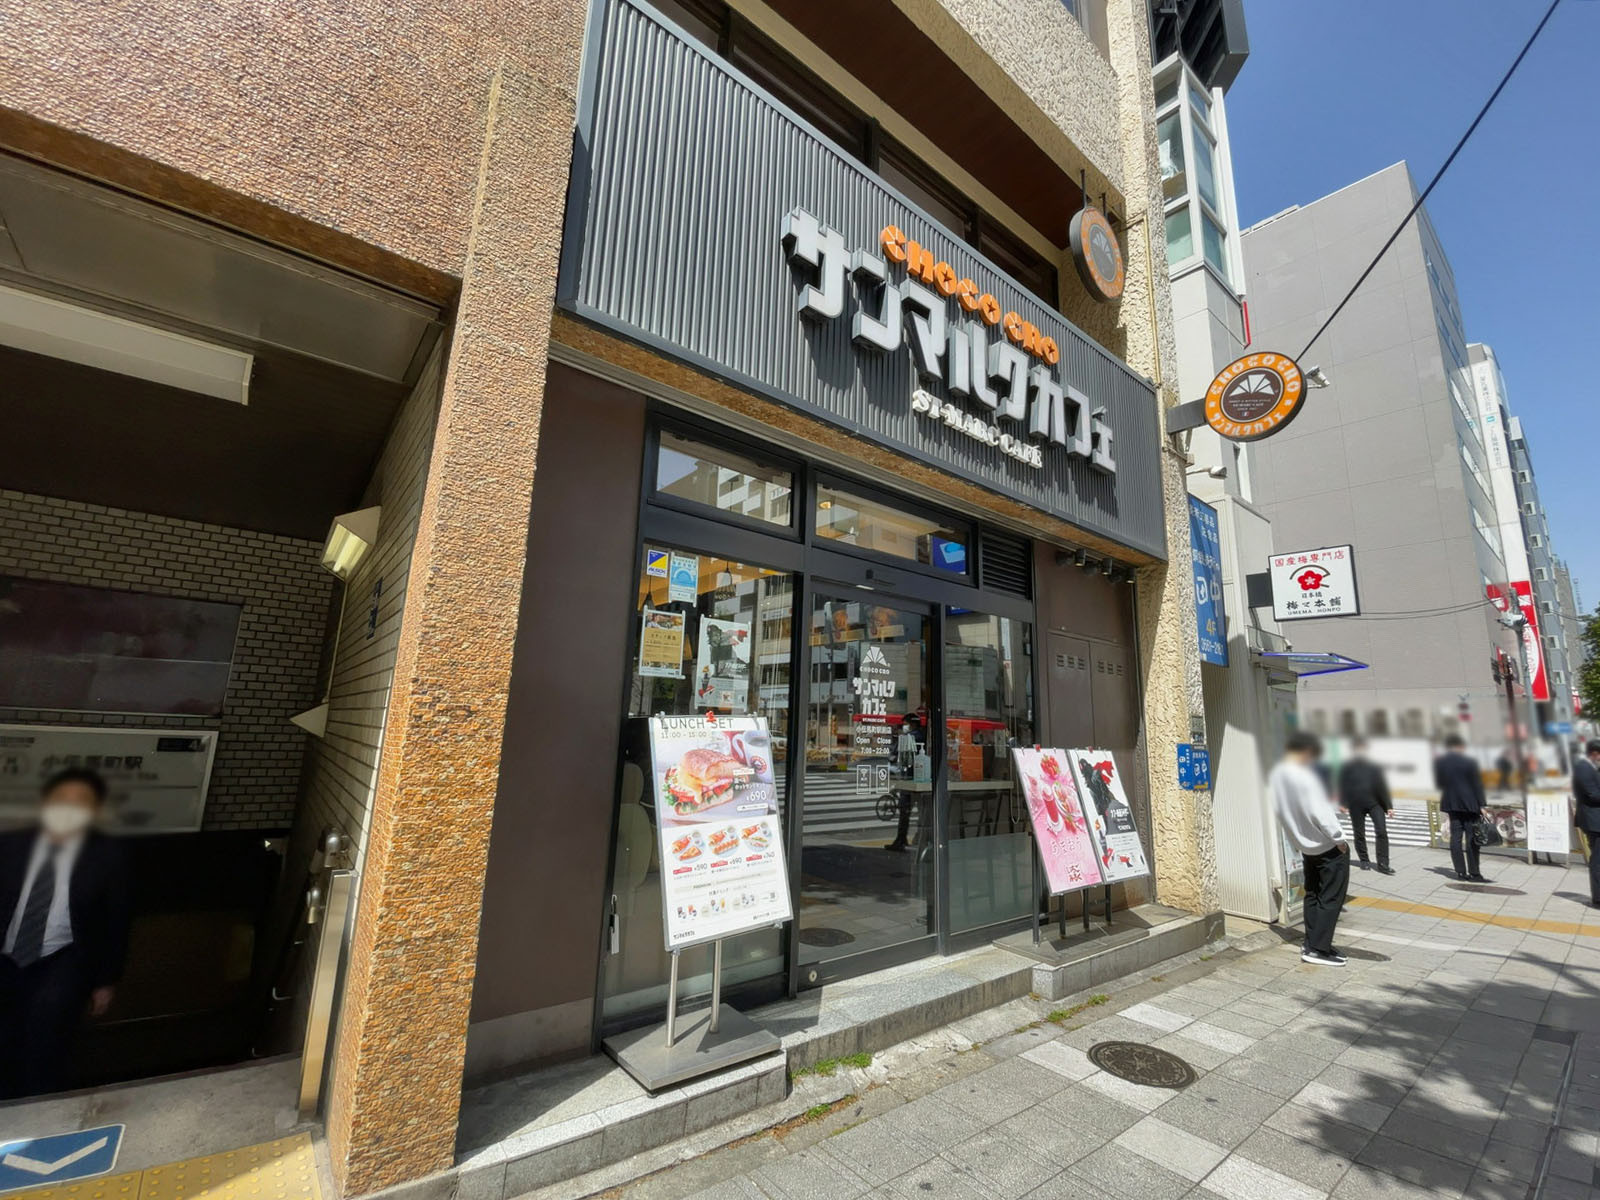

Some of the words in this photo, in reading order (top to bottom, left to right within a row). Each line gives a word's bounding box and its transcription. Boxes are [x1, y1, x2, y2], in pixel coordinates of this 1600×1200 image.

[880, 225, 1001, 326] CHOCO
[1003, 310, 1060, 366] CRO
[781, 205, 1117, 476] サンマルクカフェ
[852, 677, 896, 698] サンマルク
[862, 698, 887, 715] カフェ
[661, 718, 705, 729] LUNCH
[711, 718, 734, 729] SET
[42, 755, 144, 770] 小町駅
